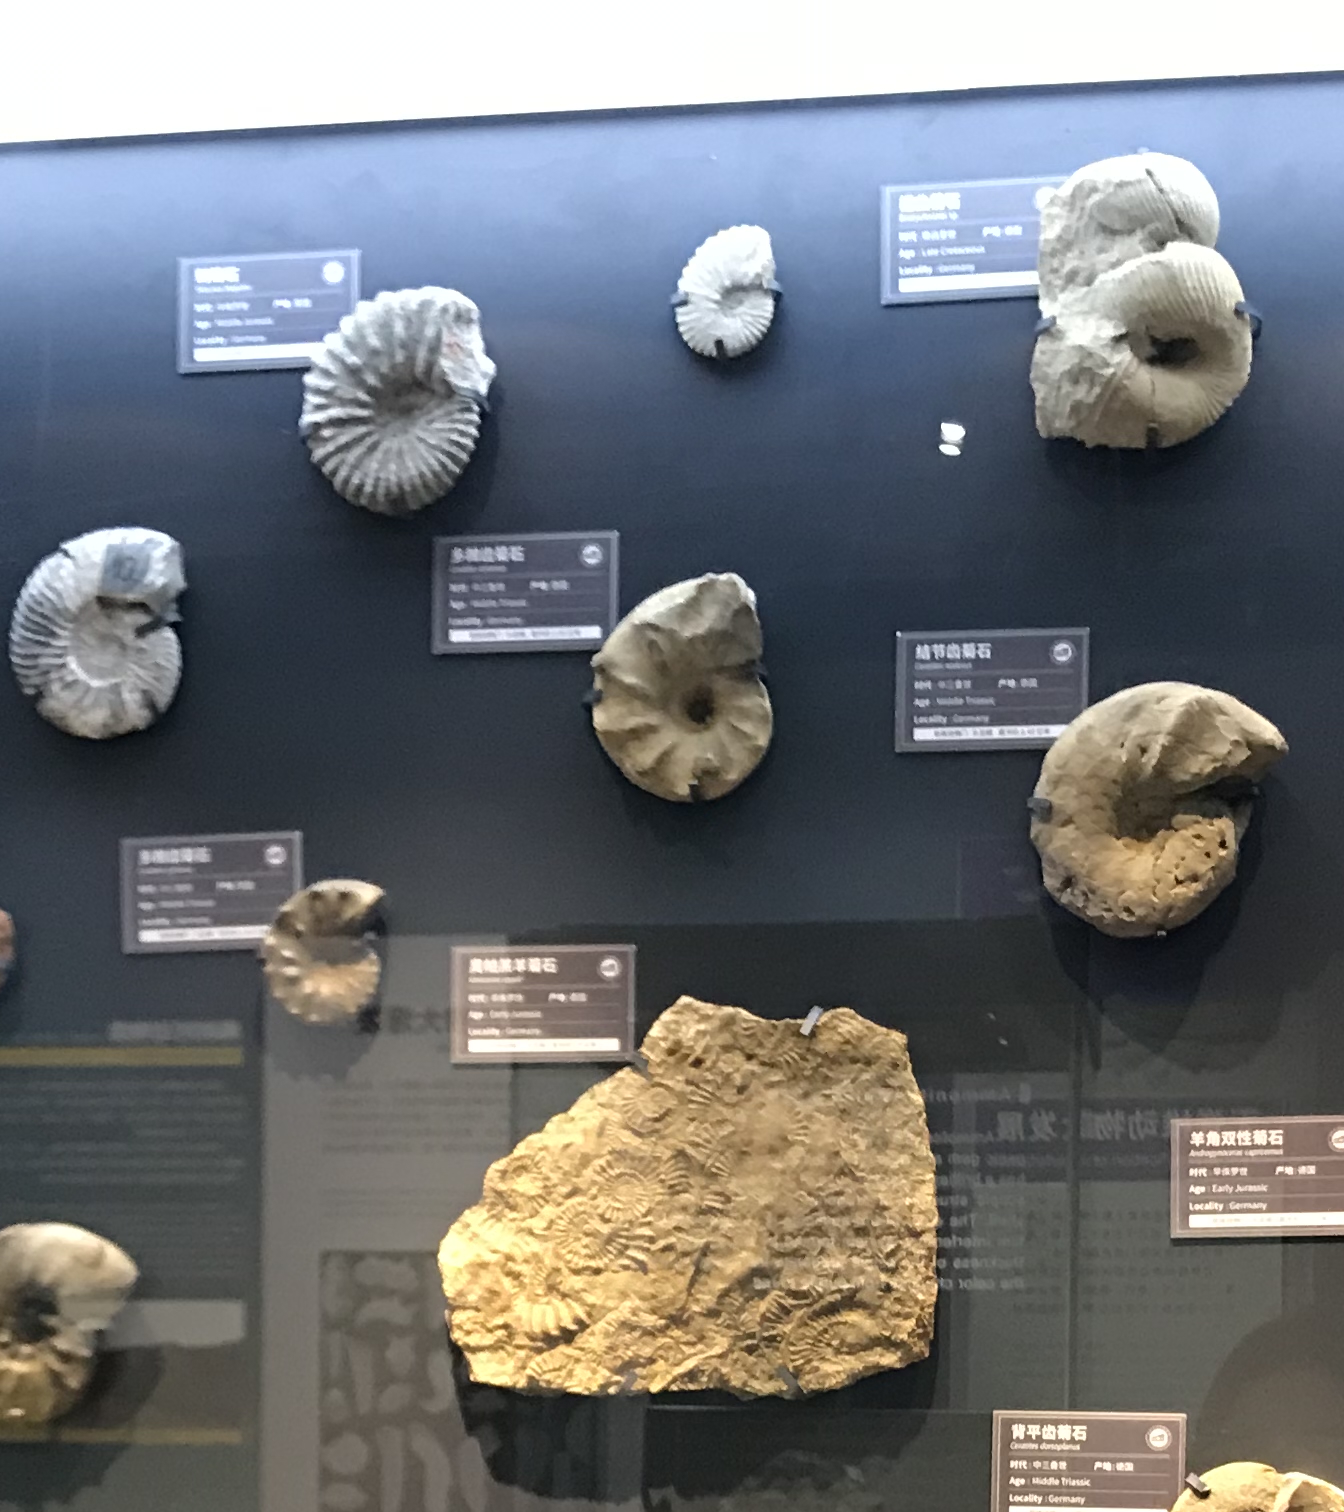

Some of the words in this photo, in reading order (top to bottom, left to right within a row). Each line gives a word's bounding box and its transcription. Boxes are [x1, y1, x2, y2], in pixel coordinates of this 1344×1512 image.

[914, 715, 947, 724] Locality
[468, 1028, 500, 1036] Locality
[1190, 1130, 1283, 1146] 羊角双性菊石
[1189, 1167, 1206, 1177] 时代
[1213, 1167, 1247, 1176] 早侏罗世
[1275, 1166, 1293, 1175] 产地
[1298, 1165, 1316, 1174] 德国
[1189, 1185, 1205, 1194] Age
[1212, 1184, 1233, 1193] Early
[1235, 1184, 1267, 1192] Jurassic
[1189, 1202, 1223, 1211] Locality
[1230, 1202, 1267, 1210] Germany
[1011, 1424, 1087, 1441] 背平齿菊石
[1010, 1461, 1027, 1469] 时代
[1094, 1461, 1111, 1471] 产地
[1116, 1462, 1133, 1471] 德国
[1009, 1478, 1025, 1486] Age
[1032, 1478, 1059, 1486] Middle
[1061, 1478, 1090, 1486] Triassic
[1009, 1494, 1042, 1504] Locality
[1049, 1495, 1085, 1505] Germany
